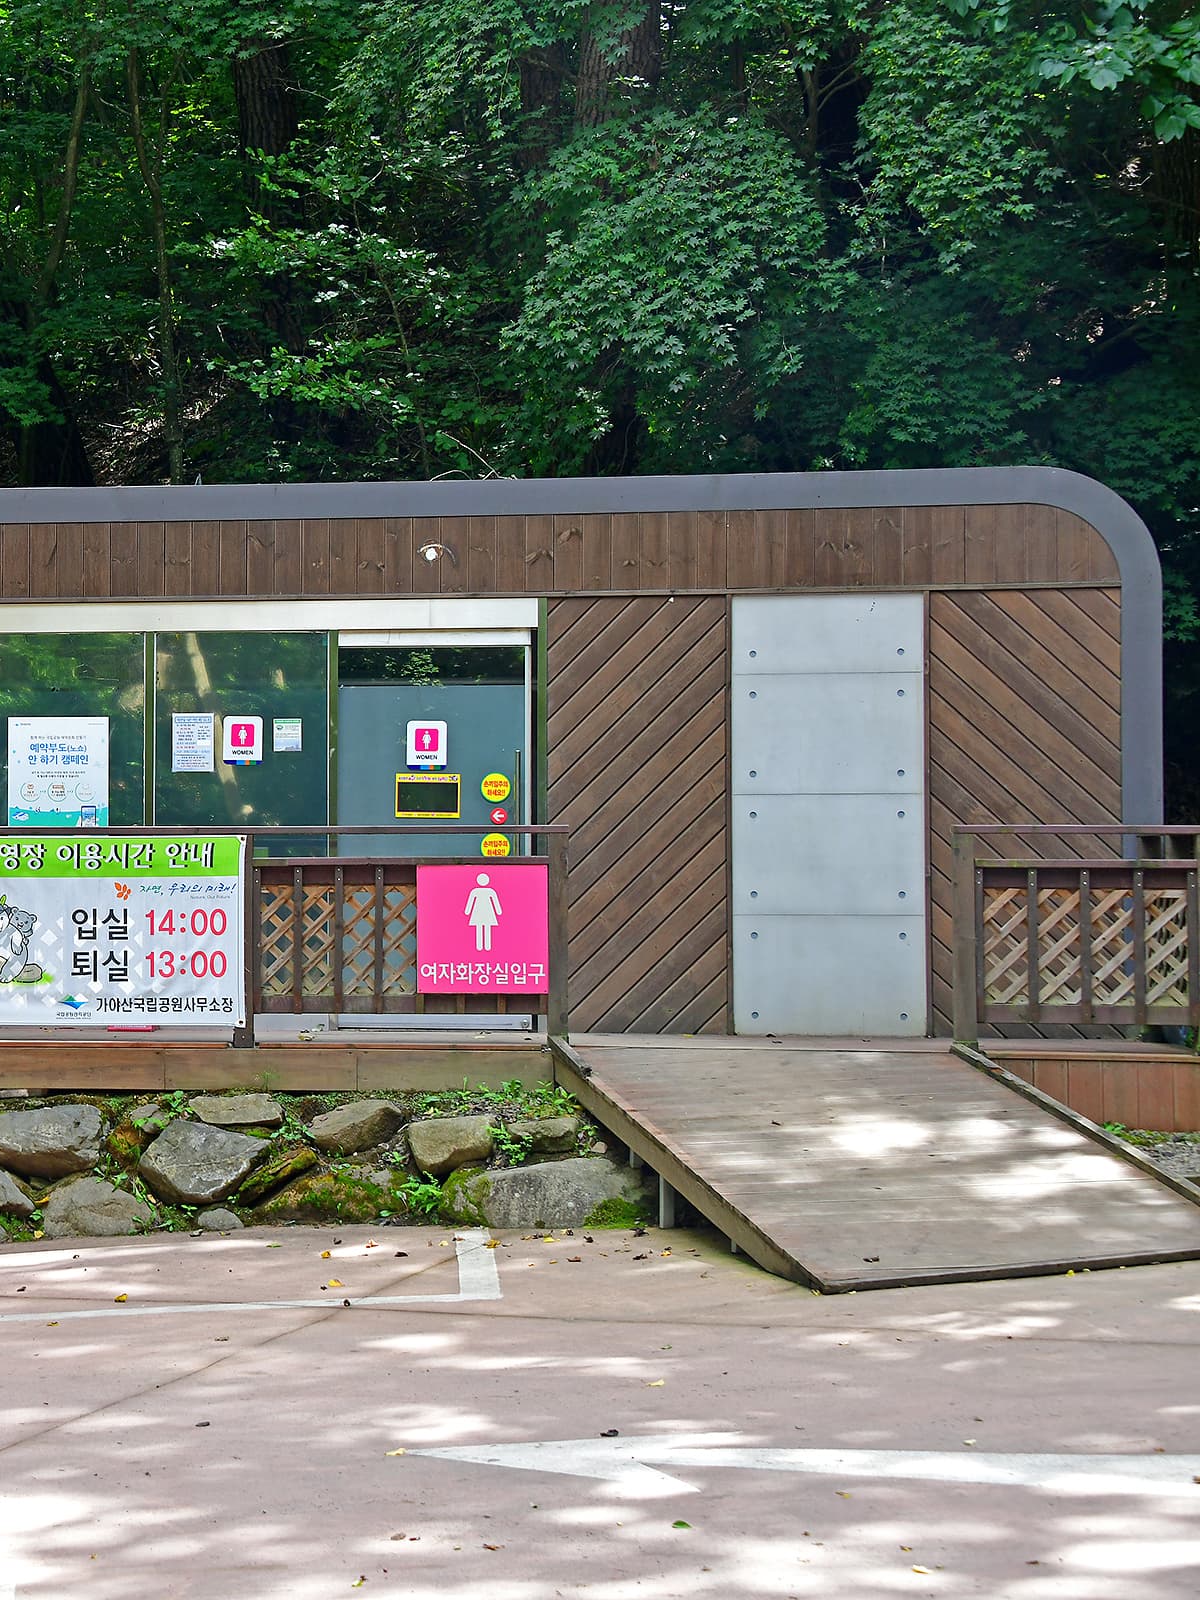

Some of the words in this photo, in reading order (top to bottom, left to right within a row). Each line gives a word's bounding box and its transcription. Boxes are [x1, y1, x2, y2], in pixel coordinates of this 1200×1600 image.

[28, 755, 38, 765] 안
[40, 755, 58, 765] 하기
[56, 842, 156, 870] 이용시간
[165, 842, 216, 870] 안내
[71, 908, 129, 941] 입실
[145, 909, 228, 936] 14:00
[71, 949, 129, 982] 퇴실
[145, 950, 228, 978] 13:00
[420, 963, 546, 985] 여자화장실입구
[96, 997, 234, 1014] 가야산국립공원사무소장
